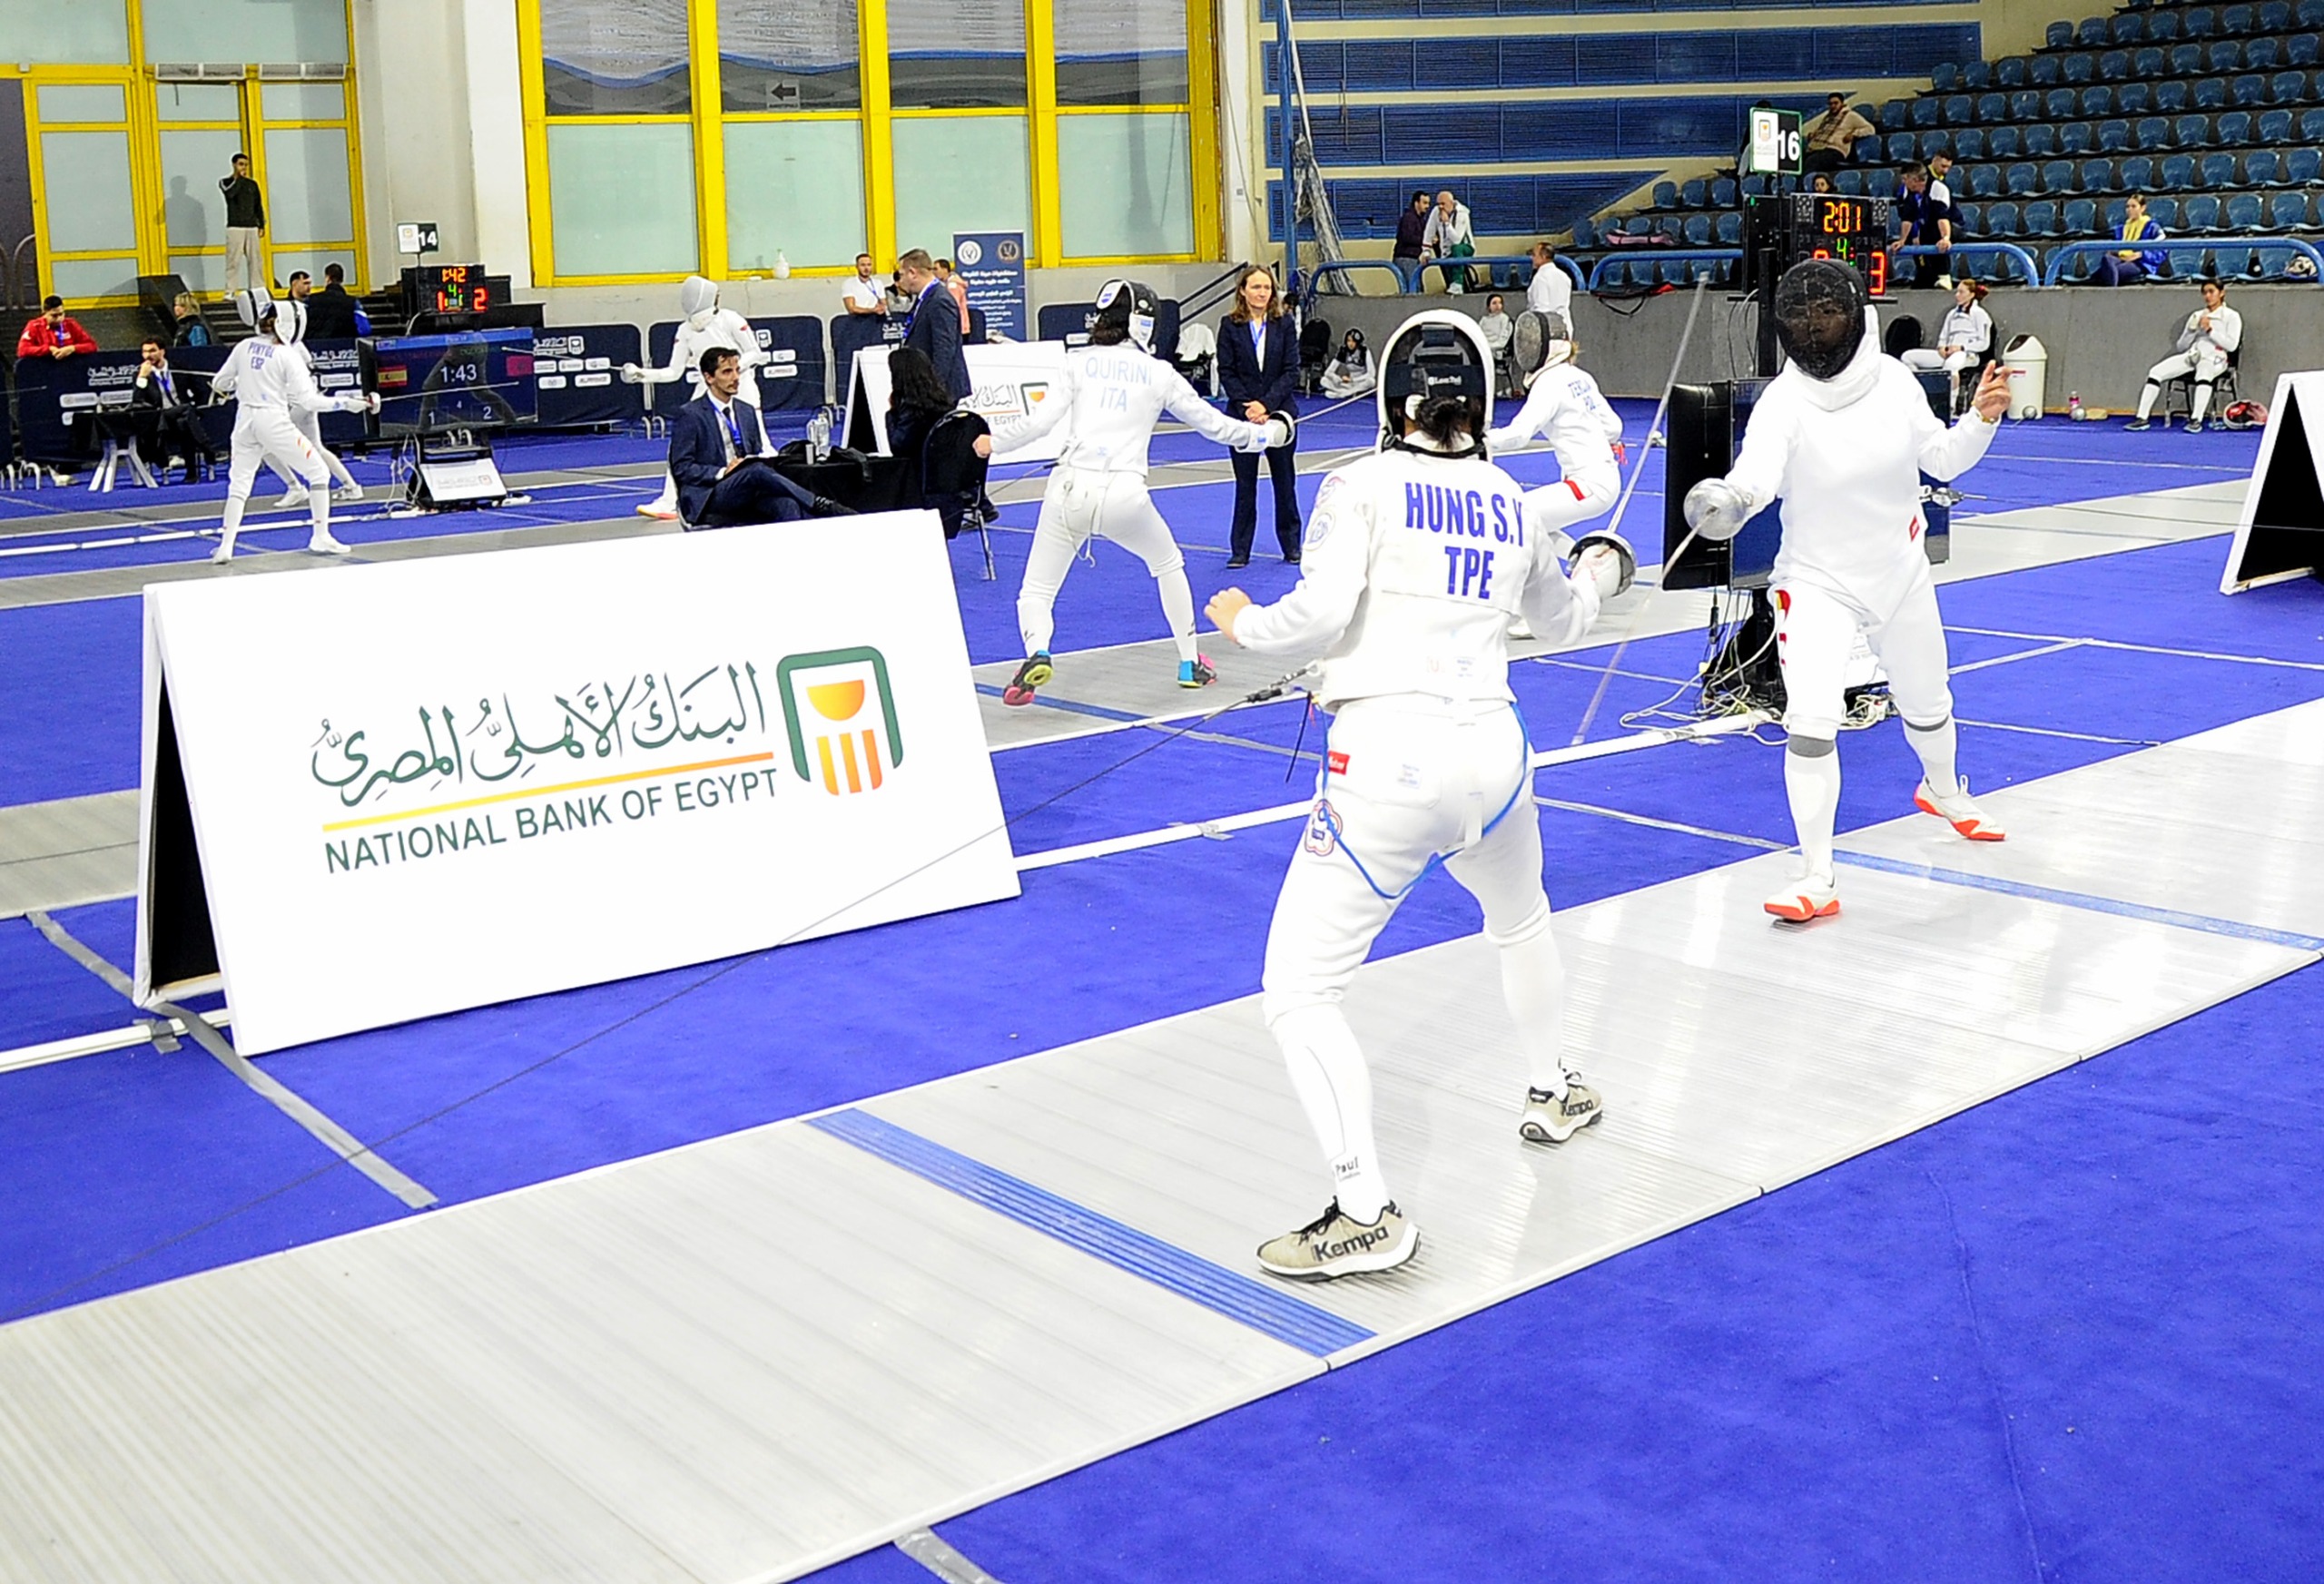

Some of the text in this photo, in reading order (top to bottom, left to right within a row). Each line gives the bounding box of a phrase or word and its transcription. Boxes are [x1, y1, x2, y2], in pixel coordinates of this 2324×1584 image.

[1778, 130, 1800, 161] 16
[1824, 202, 1861, 232] 2:01
[419, 231, 438, 247] 14
[1869, 251, 1885, 294] 3
[473, 288, 487, 310] 2
[441, 364, 478, 382] 1:43
[1085, 356, 1152, 387] QUIRINI
[1099, 387, 1128, 412] ITA
[1405, 482, 1485, 537] HUNG
[1445, 546, 1494, 599] TPE
[325, 768, 778, 874] NATIONAL BANK OF EGYPT
[1313, 1225, 1390, 1263] Kempa
